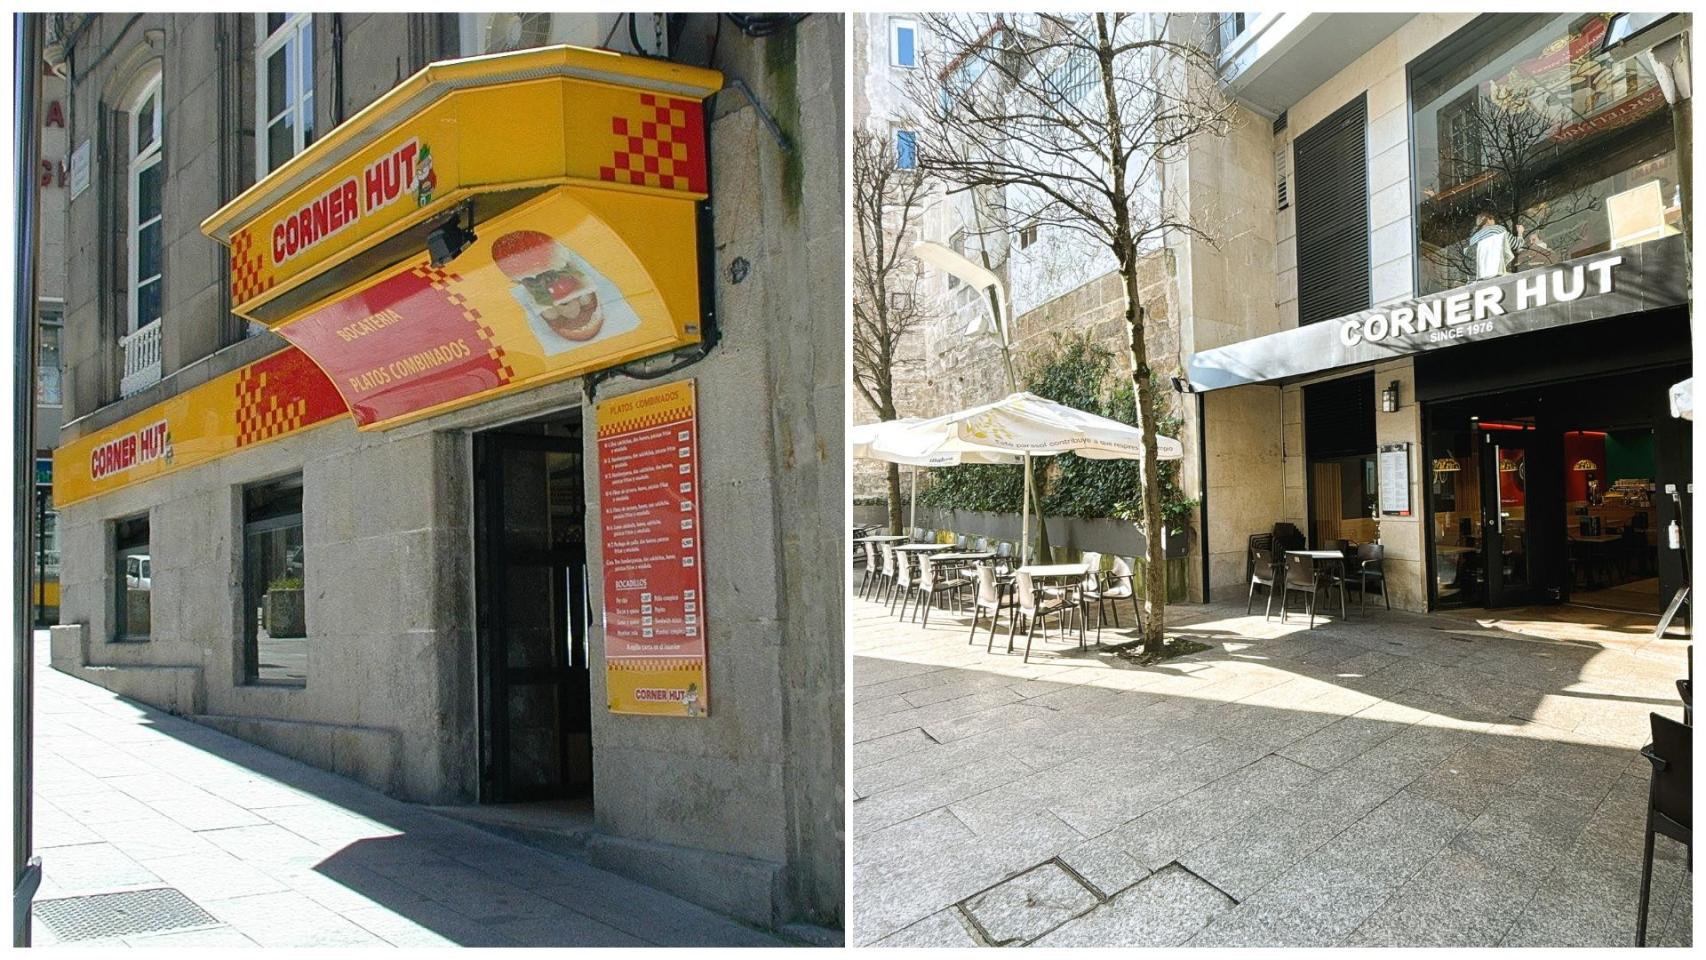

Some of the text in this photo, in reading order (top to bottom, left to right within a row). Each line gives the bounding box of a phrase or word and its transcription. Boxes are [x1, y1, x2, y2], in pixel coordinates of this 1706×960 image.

[272, 139, 418, 265] CORNER HUT
[1340, 255, 1626, 347] CORNER HUT
[337, 308, 404, 342] BOCATERIA
[1430, 322, 1494, 343] SINCE 1976
[349, 338, 472, 393] PLATOS COMBINADOS
[609, 390, 679, 416] PLATOS COMBINADOS
[91, 420, 168, 480] CORNER HUT
[1049, 437, 1092, 447] contribuye
[635, 688, 685, 700] CORNER HUT
